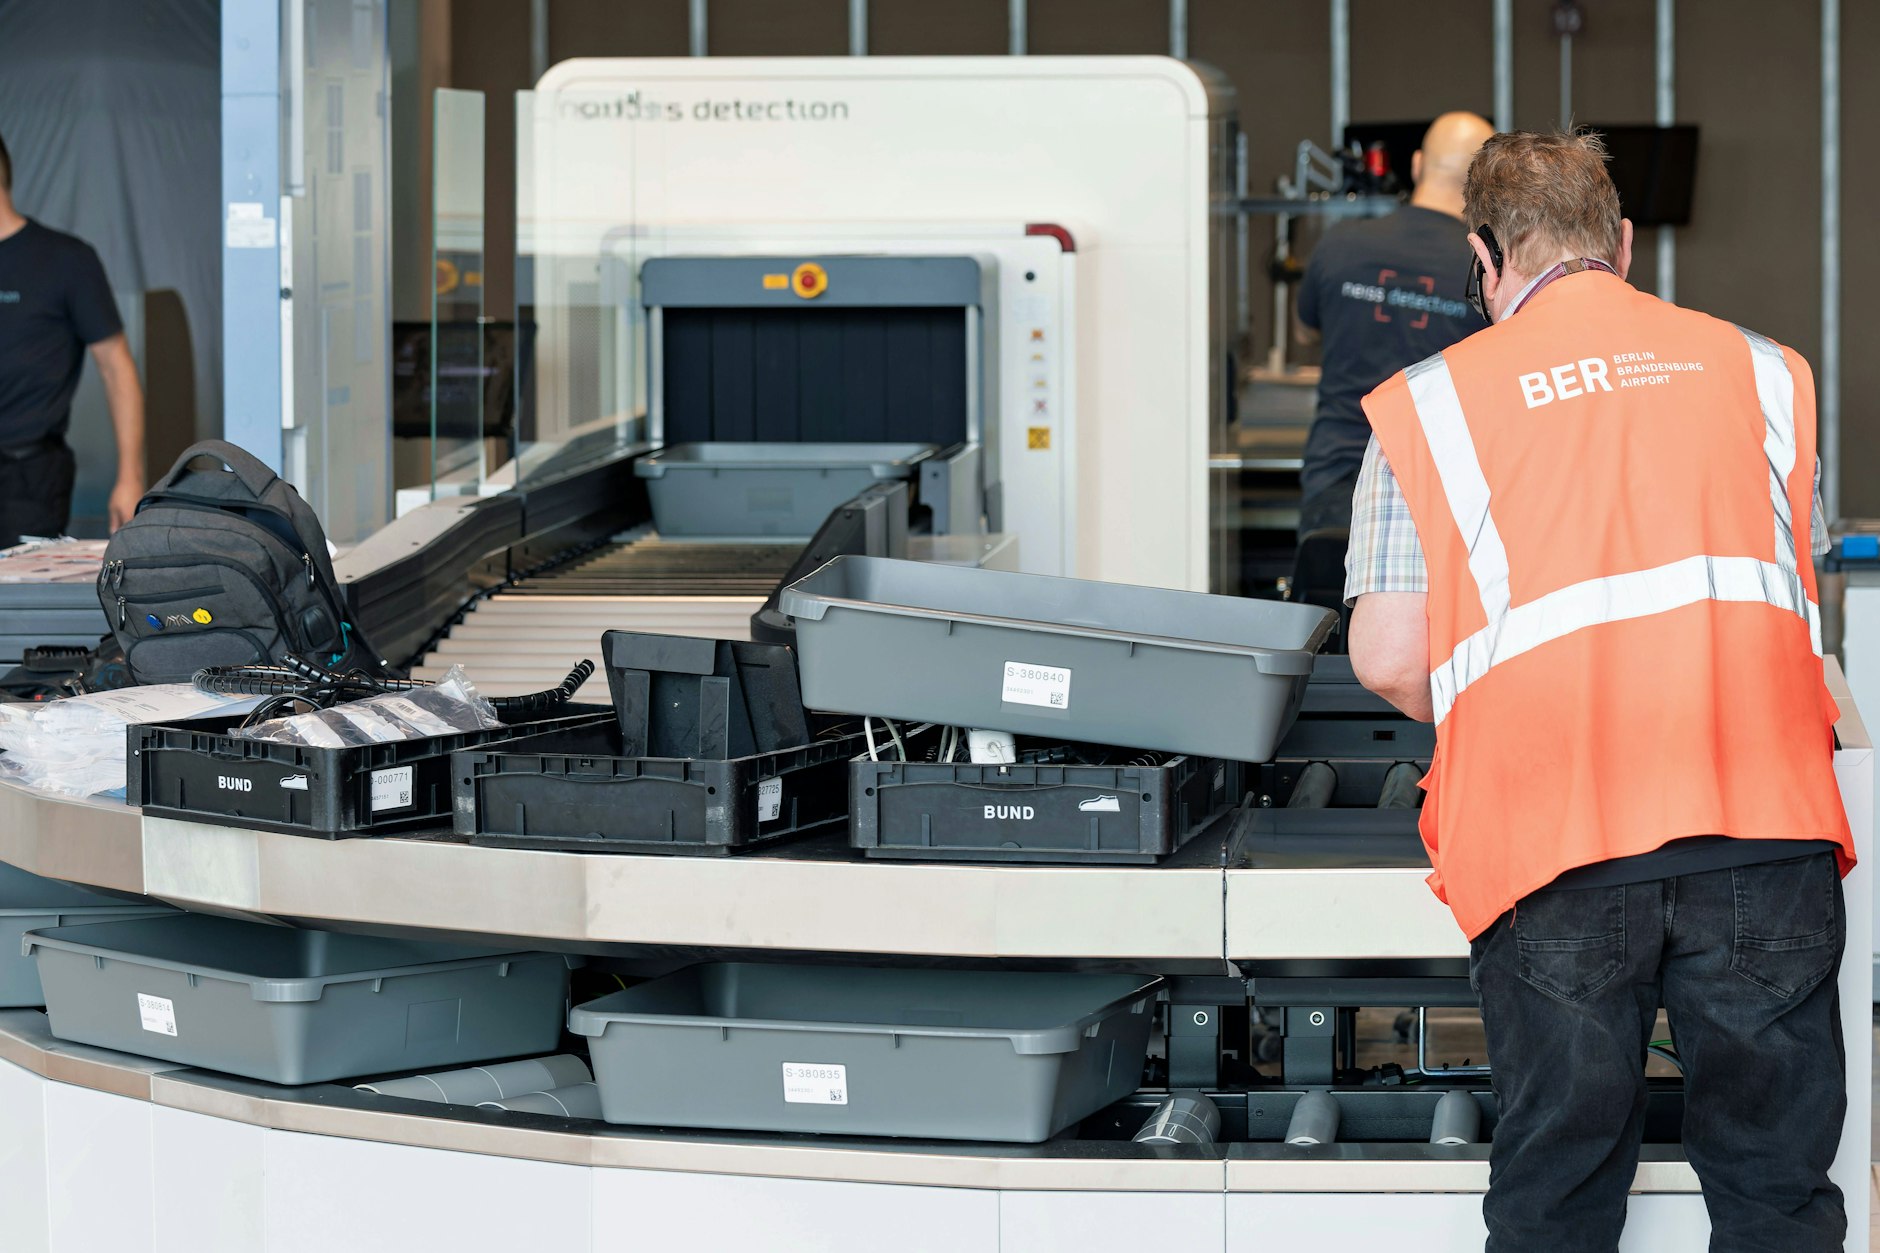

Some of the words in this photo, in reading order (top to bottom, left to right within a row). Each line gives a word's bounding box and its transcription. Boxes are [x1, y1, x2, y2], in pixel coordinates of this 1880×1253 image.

[692, 98, 849, 121] detection
[1387, 287, 1467, 318] detection
[1613, 351, 1655, 364] BERLIN
[1616, 362, 1704, 376] BRANDENBURG
[1518, 357, 1614, 409] BER
[1620, 375, 1670, 388] AIRPORT
[1006, 666, 1065, 683] S-380840
[217, 775, 252, 792] BUND
[984, 804, 1035, 821] BUND
[785, 1067, 841, 1080] S-380835
